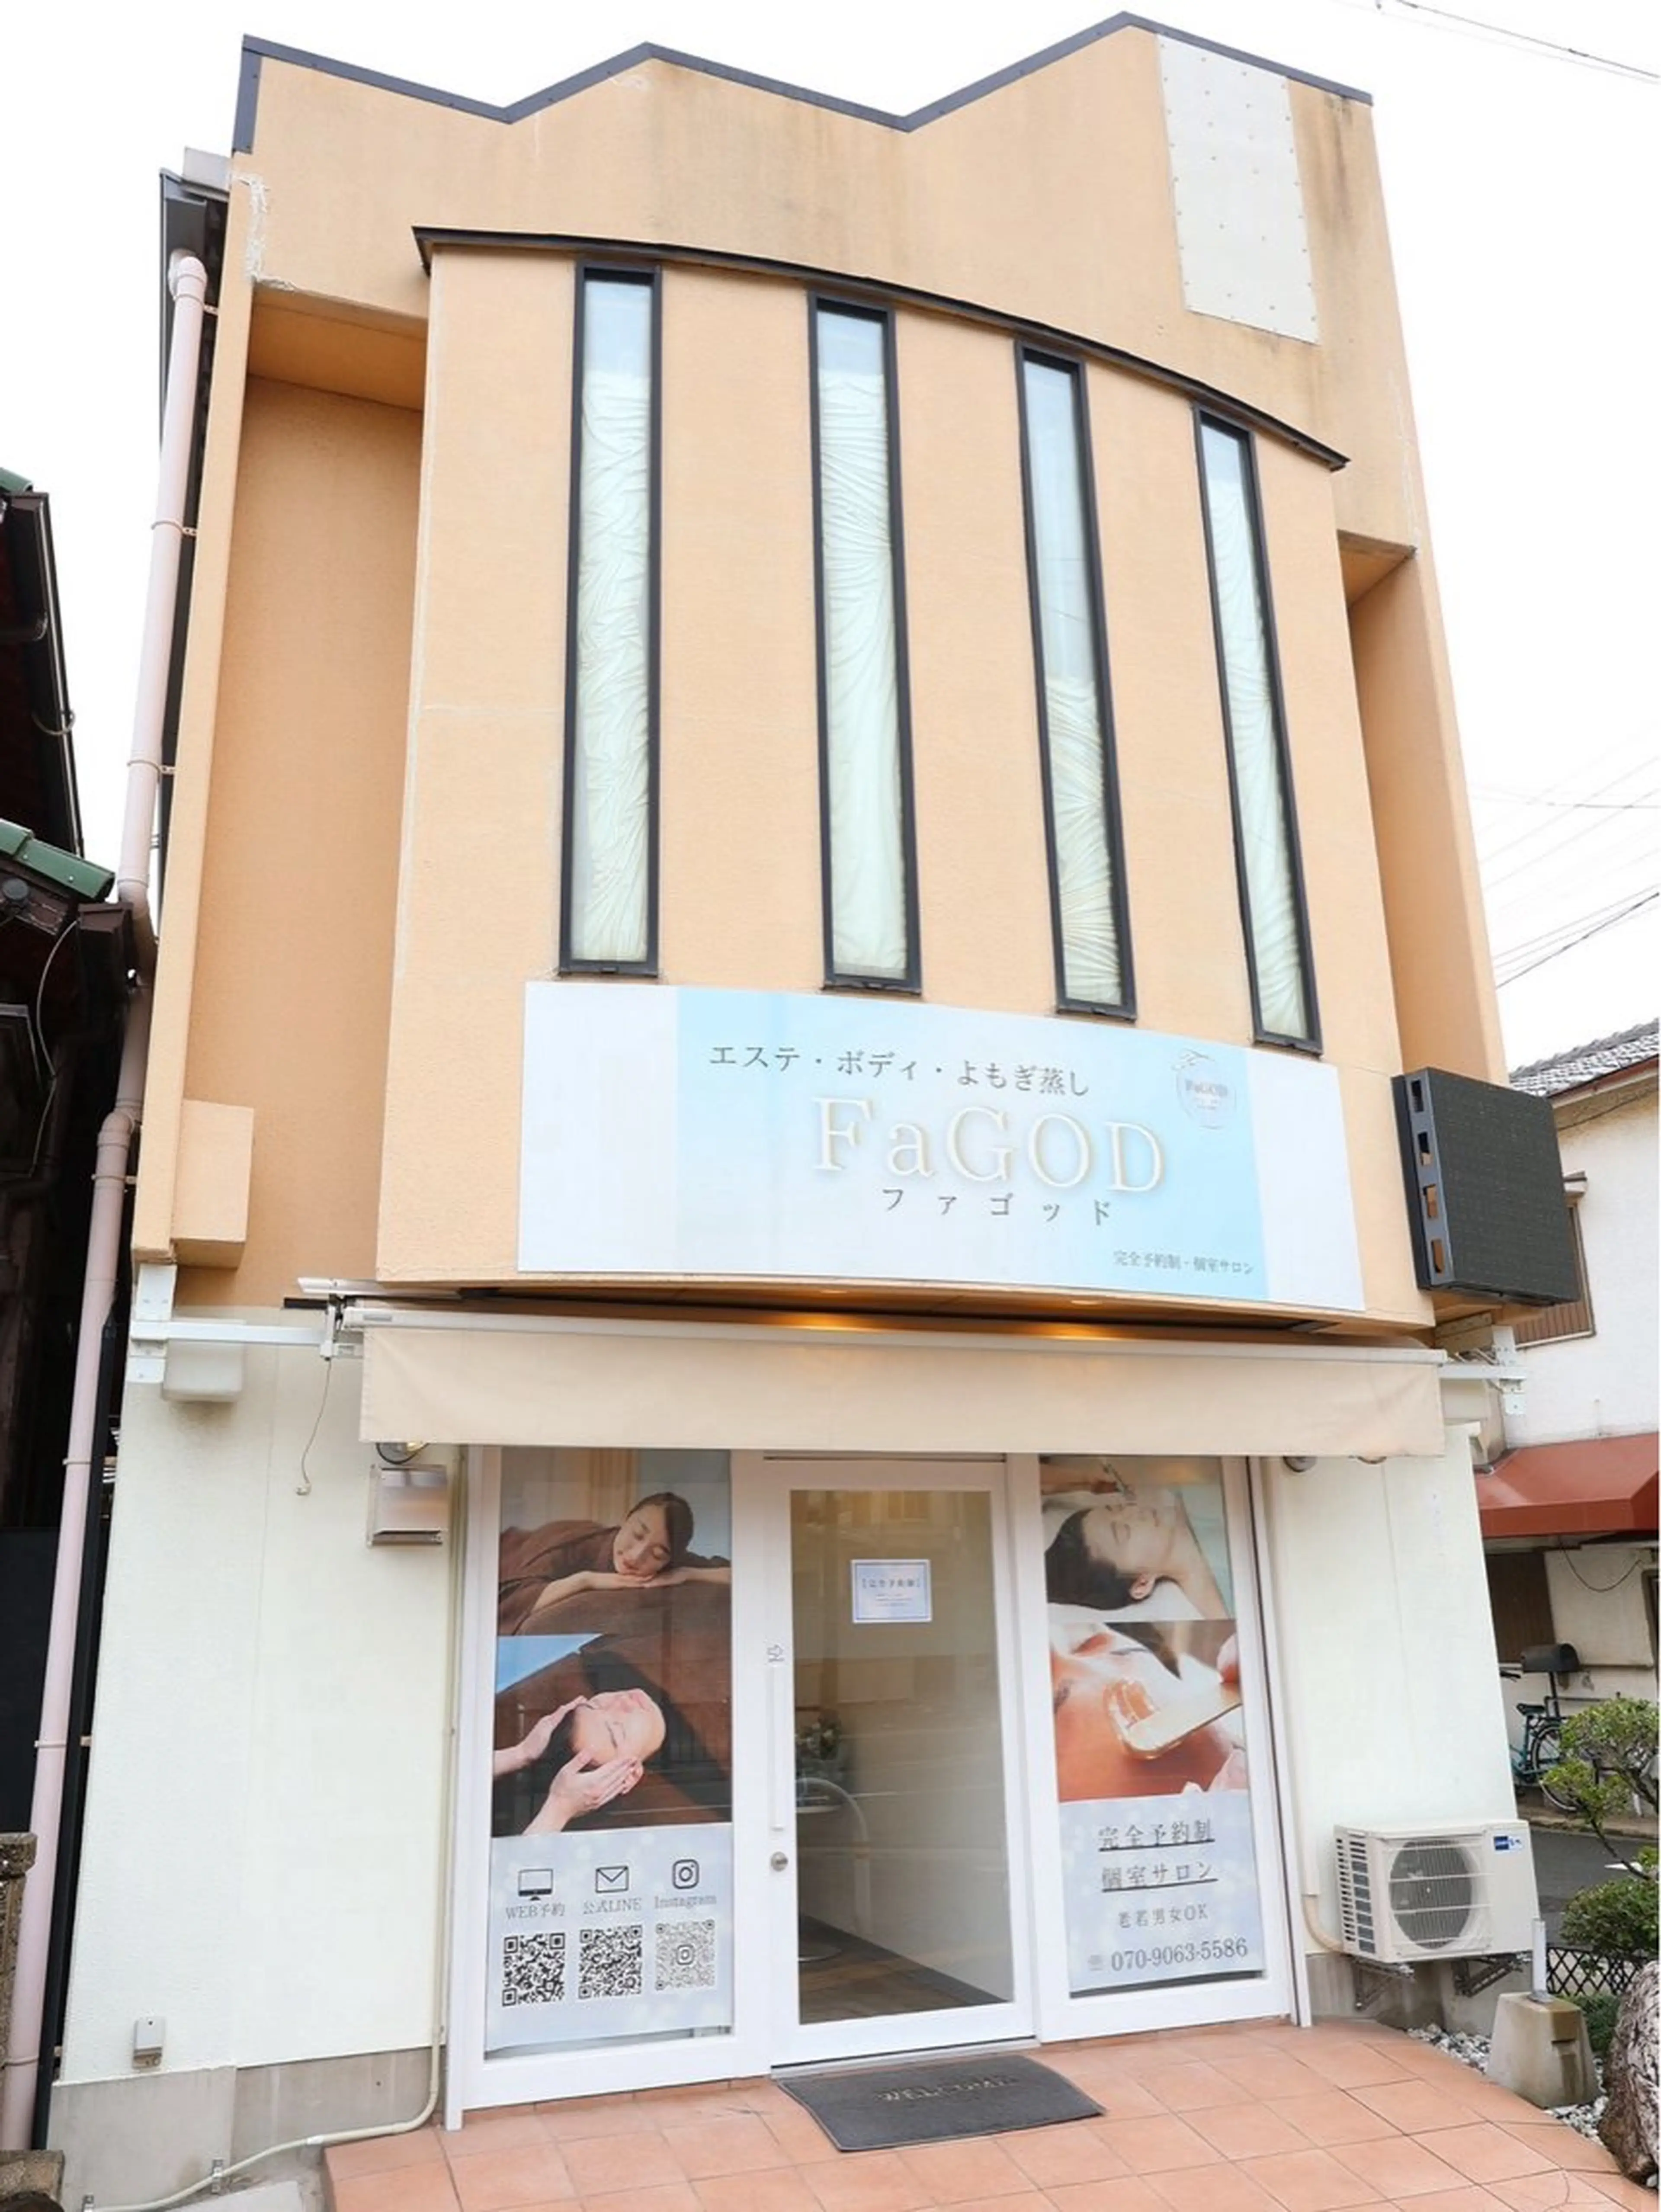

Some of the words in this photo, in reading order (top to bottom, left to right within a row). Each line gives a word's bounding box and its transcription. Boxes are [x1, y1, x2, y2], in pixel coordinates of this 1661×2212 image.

[709, 1046, 1089, 1096] エステ・ボディ・よもぎ蒸し
[813, 1096, 1165, 1193] FaGOD
[882, 1187, 1111, 1226] ファゴッド
[1098, 1818, 1211, 1850] 完全予約制
[1101, 1861, 1212, 1889] 個室サロン
[654, 1895, 718, 1910] Instagram
[1110, 1936, 1249, 1972] 070-9063-5586
